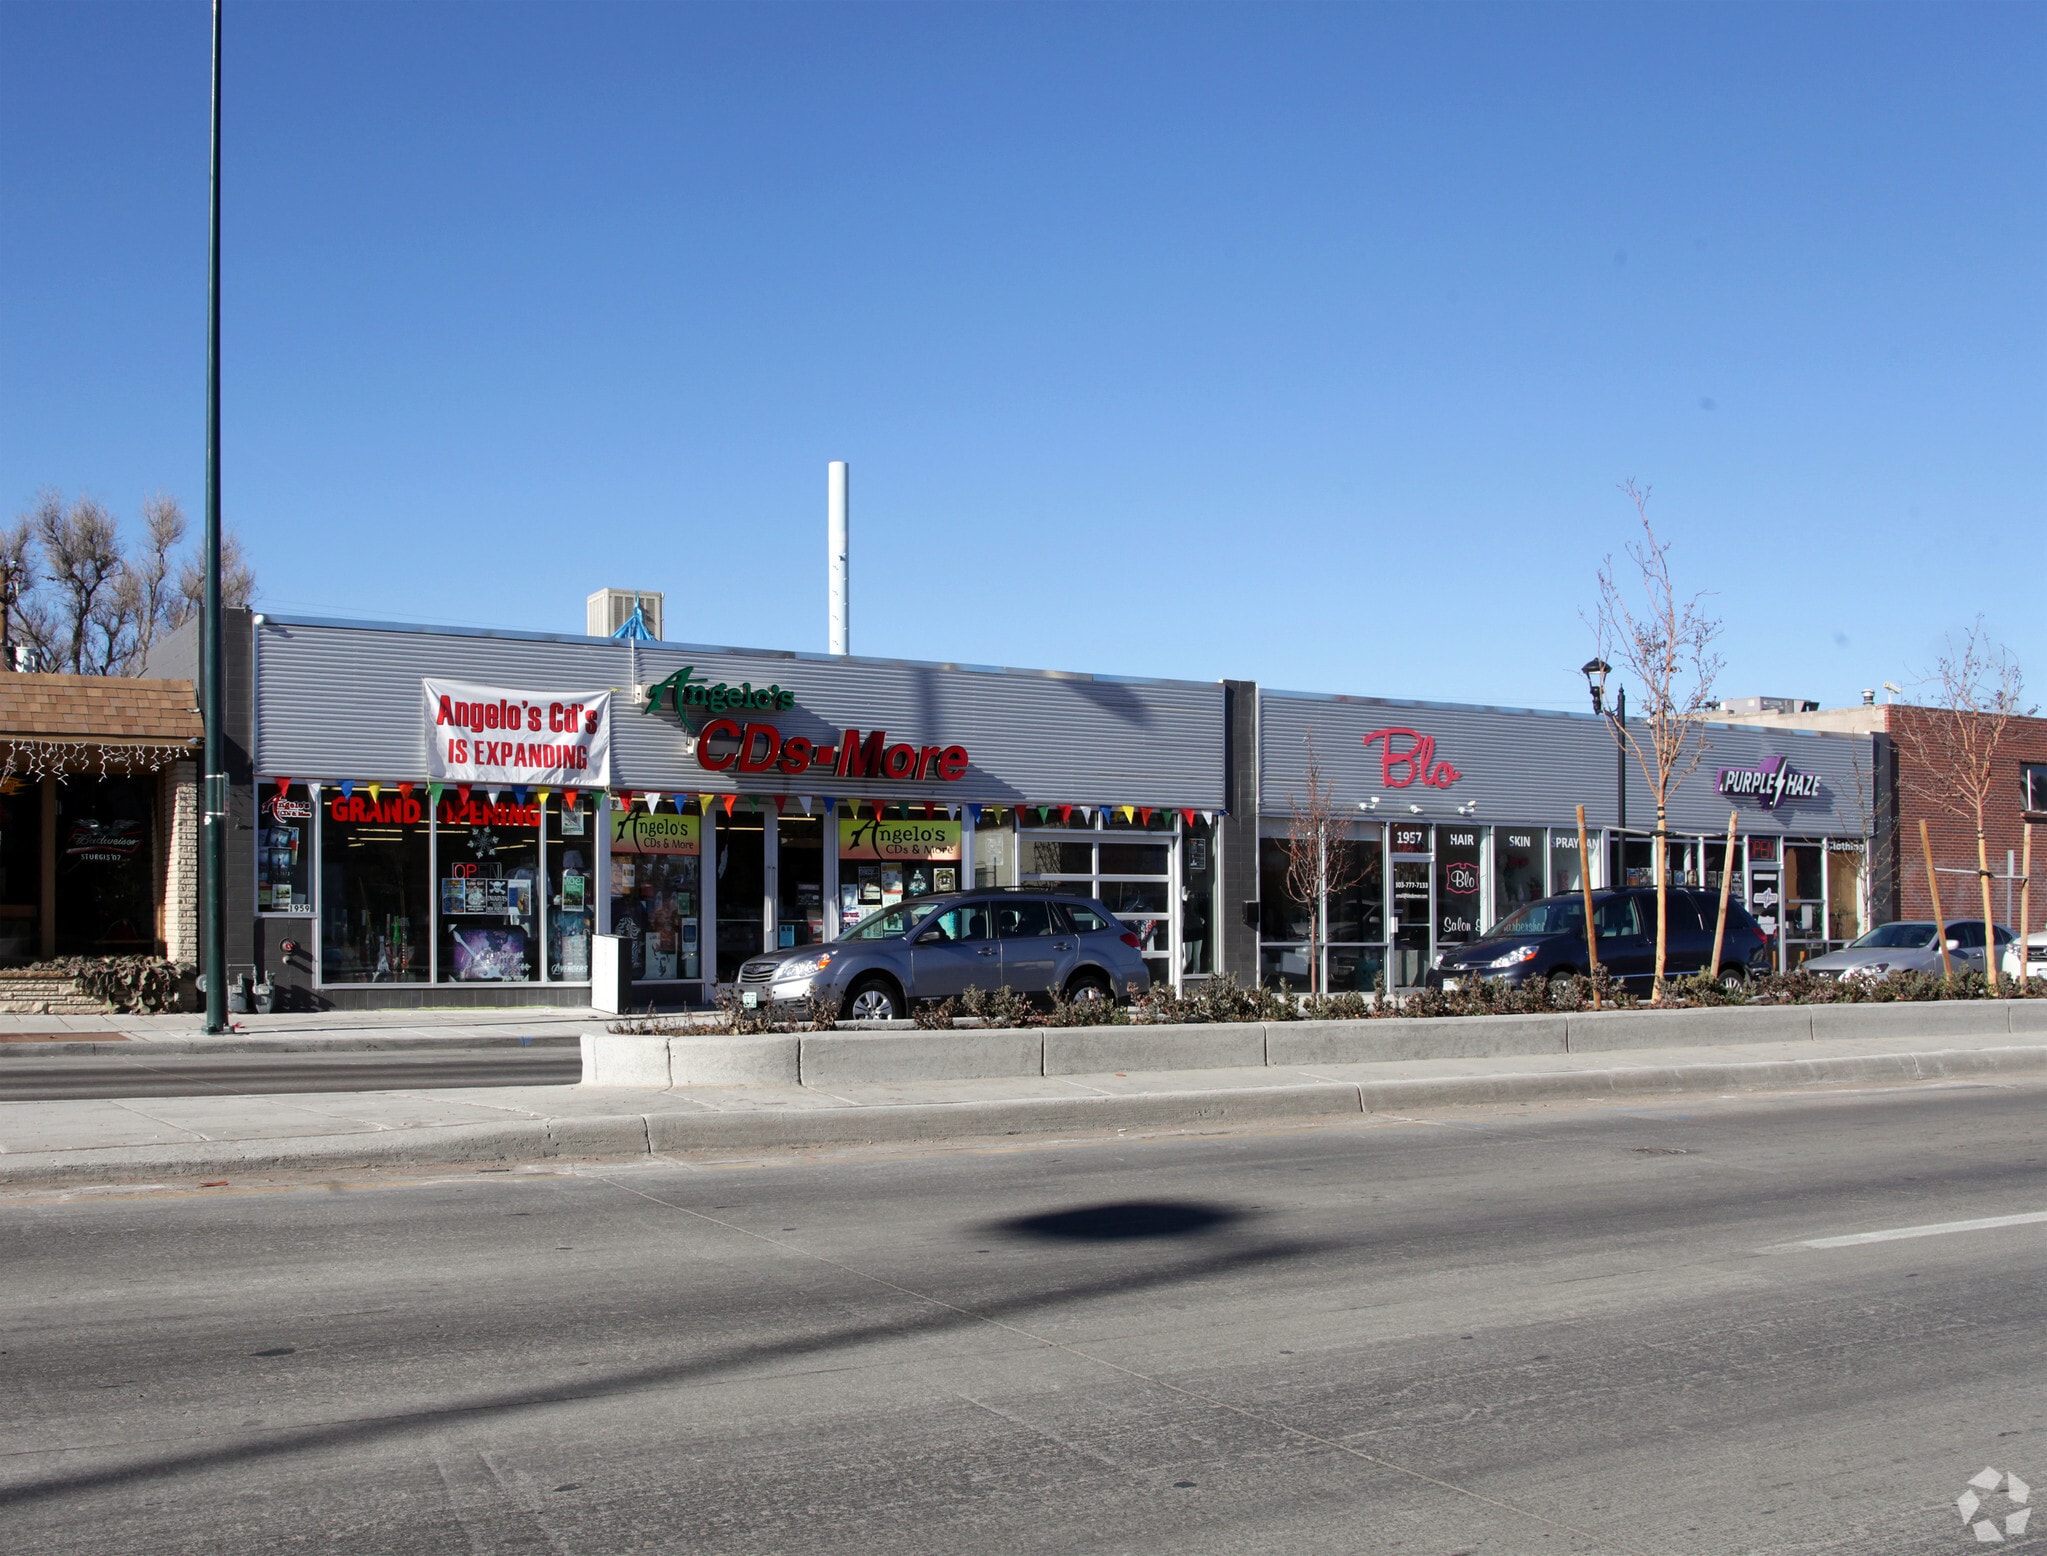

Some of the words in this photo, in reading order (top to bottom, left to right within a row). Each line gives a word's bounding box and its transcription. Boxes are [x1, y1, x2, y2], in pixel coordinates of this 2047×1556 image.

[645, 666, 795, 732] Angelo's
[436, 694, 542, 733] Angelo's
[549, 702, 598, 735] Cd's
[448, 738, 468, 764] IS
[474, 740, 588, 770] EXPANDING
[1363, 727, 1461, 788] Blo
[1725, 771, 1777, 794] PURPLE
[1785, 774, 1822, 796] HAZE
[261, 793, 310, 823] Angelo's
[331, 796, 421, 824] GRAND
[437, 801, 541, 827] OPENING
[615, 804, 688, 854] Angelo's
[1397, 831, 1422, 844] 1957
[73, 834, 139, 845] Budweiser
[644, 838, 660, 848] CDs
[663, 839, 670, 848] &
[672, 840, 694, 849] More
[848, 817, 946, 860] Angelo's
[1450, 834, 1474, 846] HAIR
[1509, 836, 1531, 847] SKIN
[1551, 837, 1579, 849] SPRAY
[81, 853, 110, 861] STURGIS
[886, 844, 908, 854] CDs
[912, 844, 920, 854] &
[924, 845, 954, 855] More
[1451, 870, 1475, 888] Blo
[1444, 917, 1471, 932] Salon
